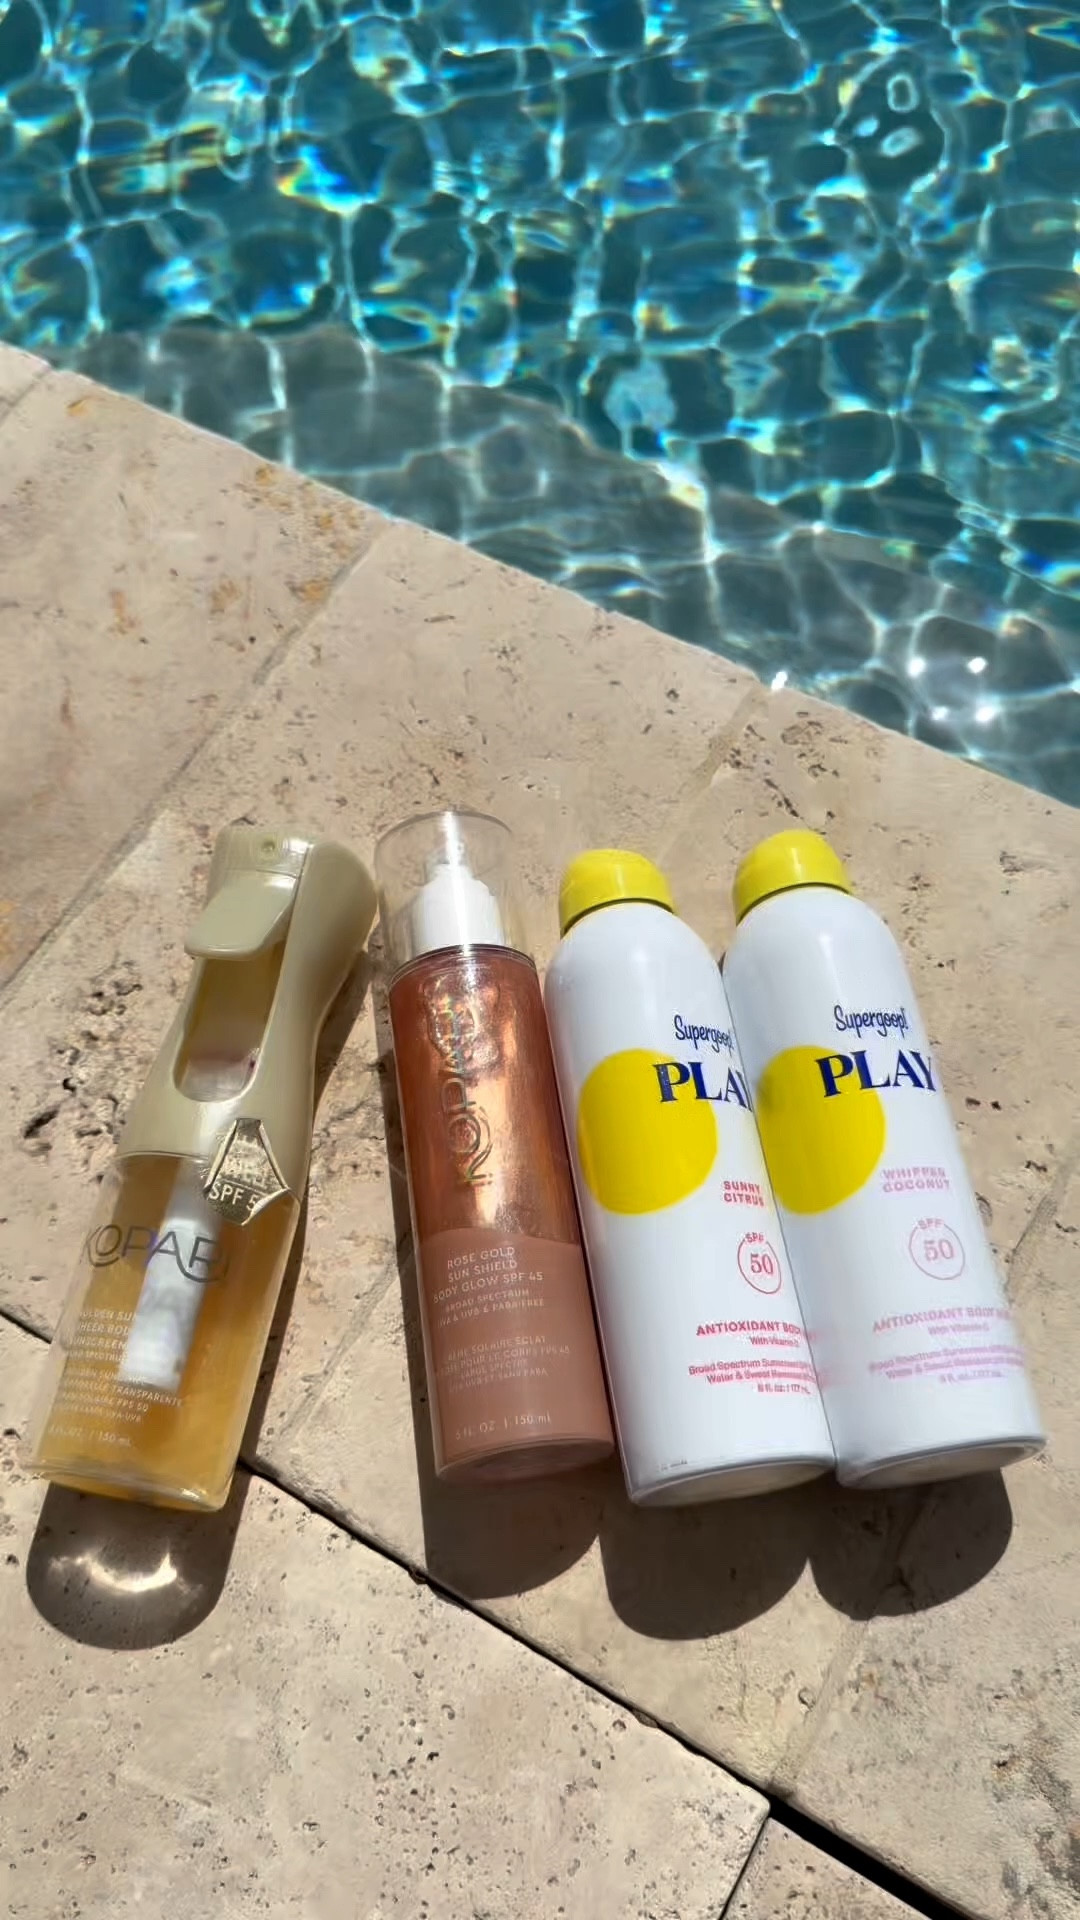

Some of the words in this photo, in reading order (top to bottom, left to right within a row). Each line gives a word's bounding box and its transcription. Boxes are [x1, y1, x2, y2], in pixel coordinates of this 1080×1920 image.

[834, 1004, 909, 1039] Supergoop!
[815, 1049, 937, 1098] PLAY
[208, 1181, 245, 1206] SPF
[723, 1180, 761, 1194] SUNNY
[882, 1178, 950, 1193] COCONUT
[723, 1193, 765, 1207] CITRUS
[745, 1231, 765, 1243] SPF
[447, 1252, 477, 1270] ROSE
[480, 1246, 516, 1261] GOLD
[923, 1239, 955, 1261] 50
[448, 1268, 469, 1283] SUN
[473, 1259, 519, 1276] SHIELD
[750, 1252, 775, 1276] 50
[461, 1274, 500, 1293] GLOW
[502, 1272, 527, 1285] SPF
[529, 1271, 545, 1282] 45
[477, 1287, 531, 1303] SPECTRUM
[79, 1322, 106, 1334] HEER
[696, 1320, 780, 1337] ANTIOXIDANT
[873, 1307, 964, 1333] ANTIOXIDANT
[688, 1363, 716, 1376] Broad
[716, 1359, 761, 1372] Spectrum
[706, 1373, 734, 1385] Water
